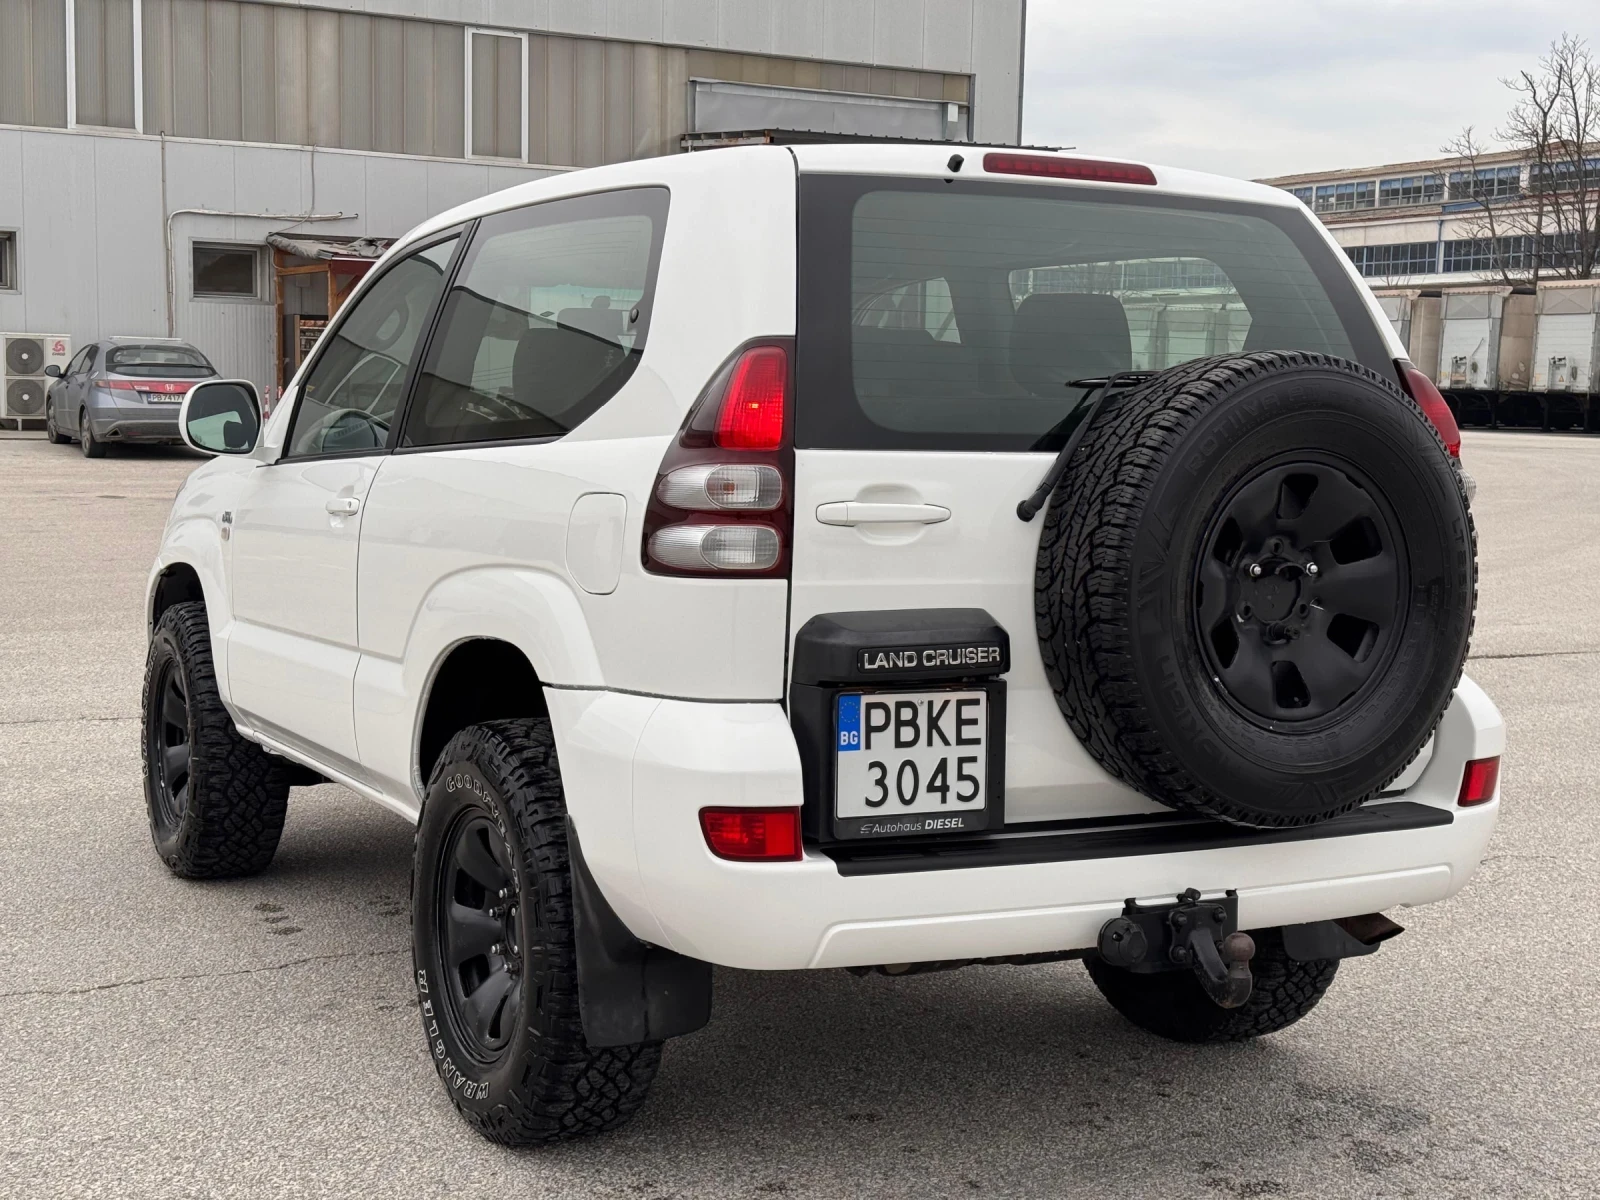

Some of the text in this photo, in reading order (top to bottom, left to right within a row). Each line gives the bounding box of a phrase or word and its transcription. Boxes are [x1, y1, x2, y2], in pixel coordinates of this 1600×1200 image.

[864, 647, 1000, 669] LAND CRUISER
[840, 731, 858, 746] BG
[864, 698, 982, 751] PBKE
[864, 756, 981, 808] 3045
[446, 773, 520, 894] GOODYEAR
[872, 818, 965, 834] Autohaus DIESEL
[417, 969, 489, 1100] WRANGLER
